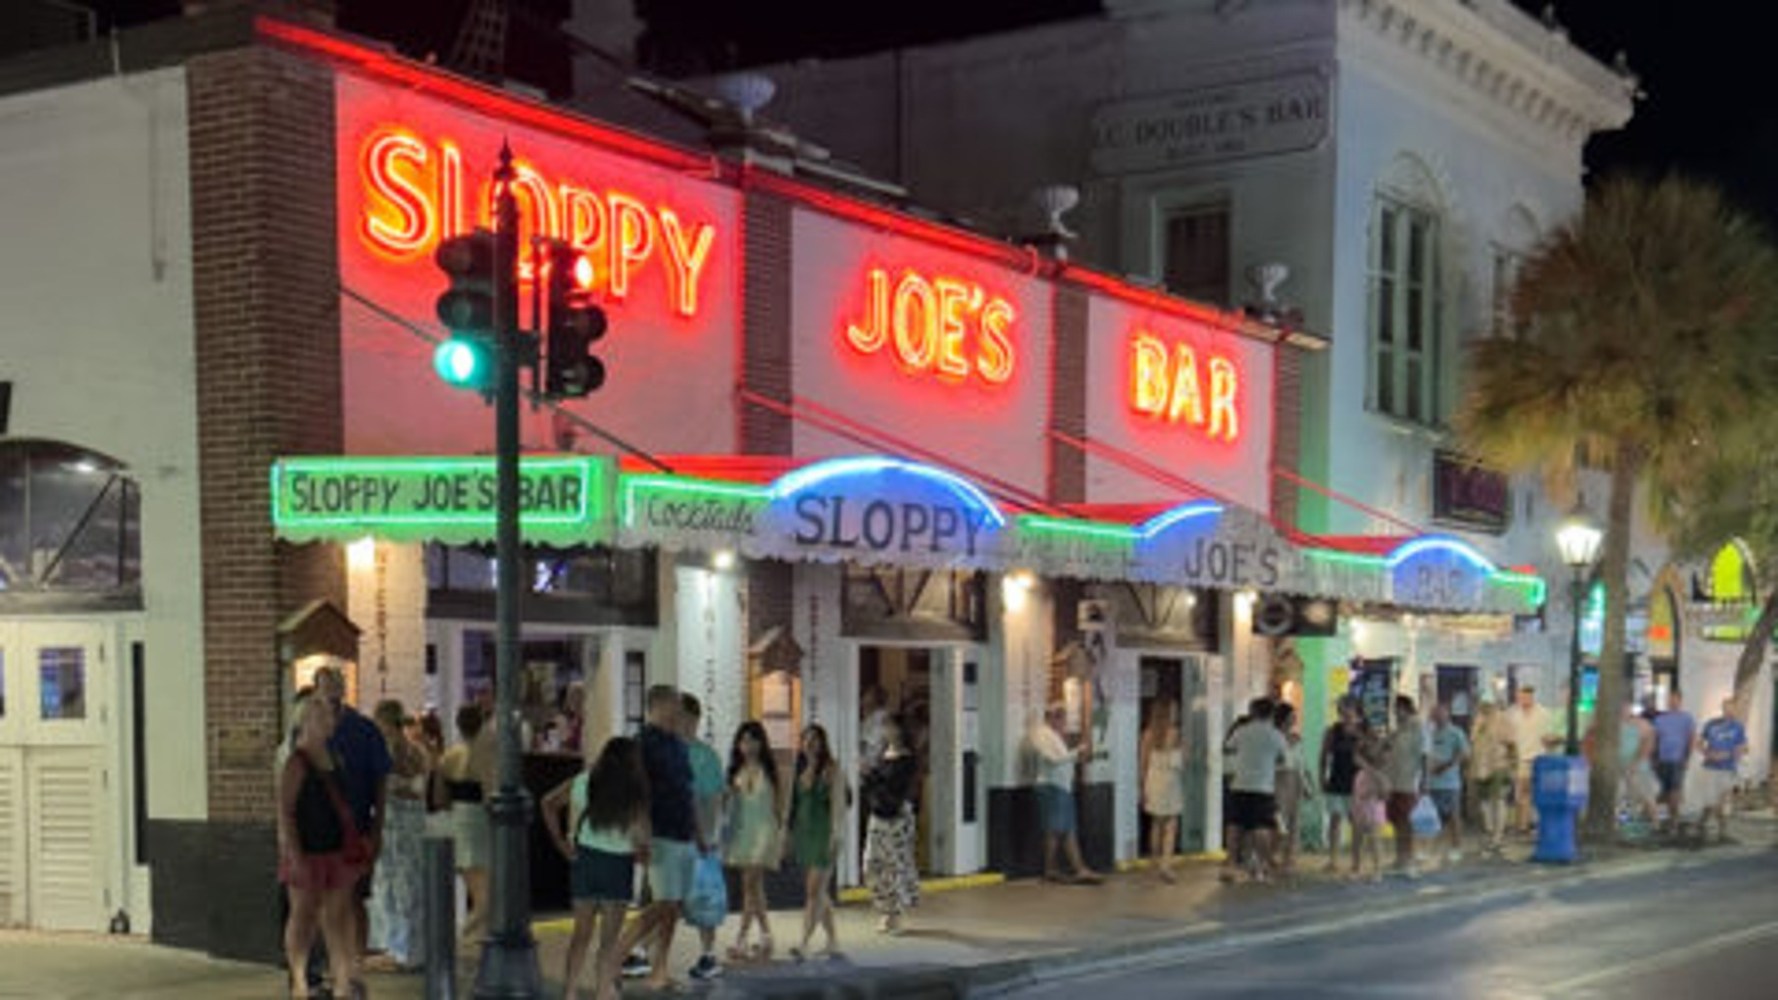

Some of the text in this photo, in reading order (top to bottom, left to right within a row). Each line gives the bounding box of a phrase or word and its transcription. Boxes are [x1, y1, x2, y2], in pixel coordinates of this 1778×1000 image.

[1267, 94, 1324, 124] BAR
[847, 268, 1015, 384] JOE'S
[1133, 333, 1239, 440] BAR
[291, 468, 582, 513] SLOPPY JOE'S BAR
[793, 496, 984, 557] SLOPPY
[1184, 537, 1279, 586] JOE'S
